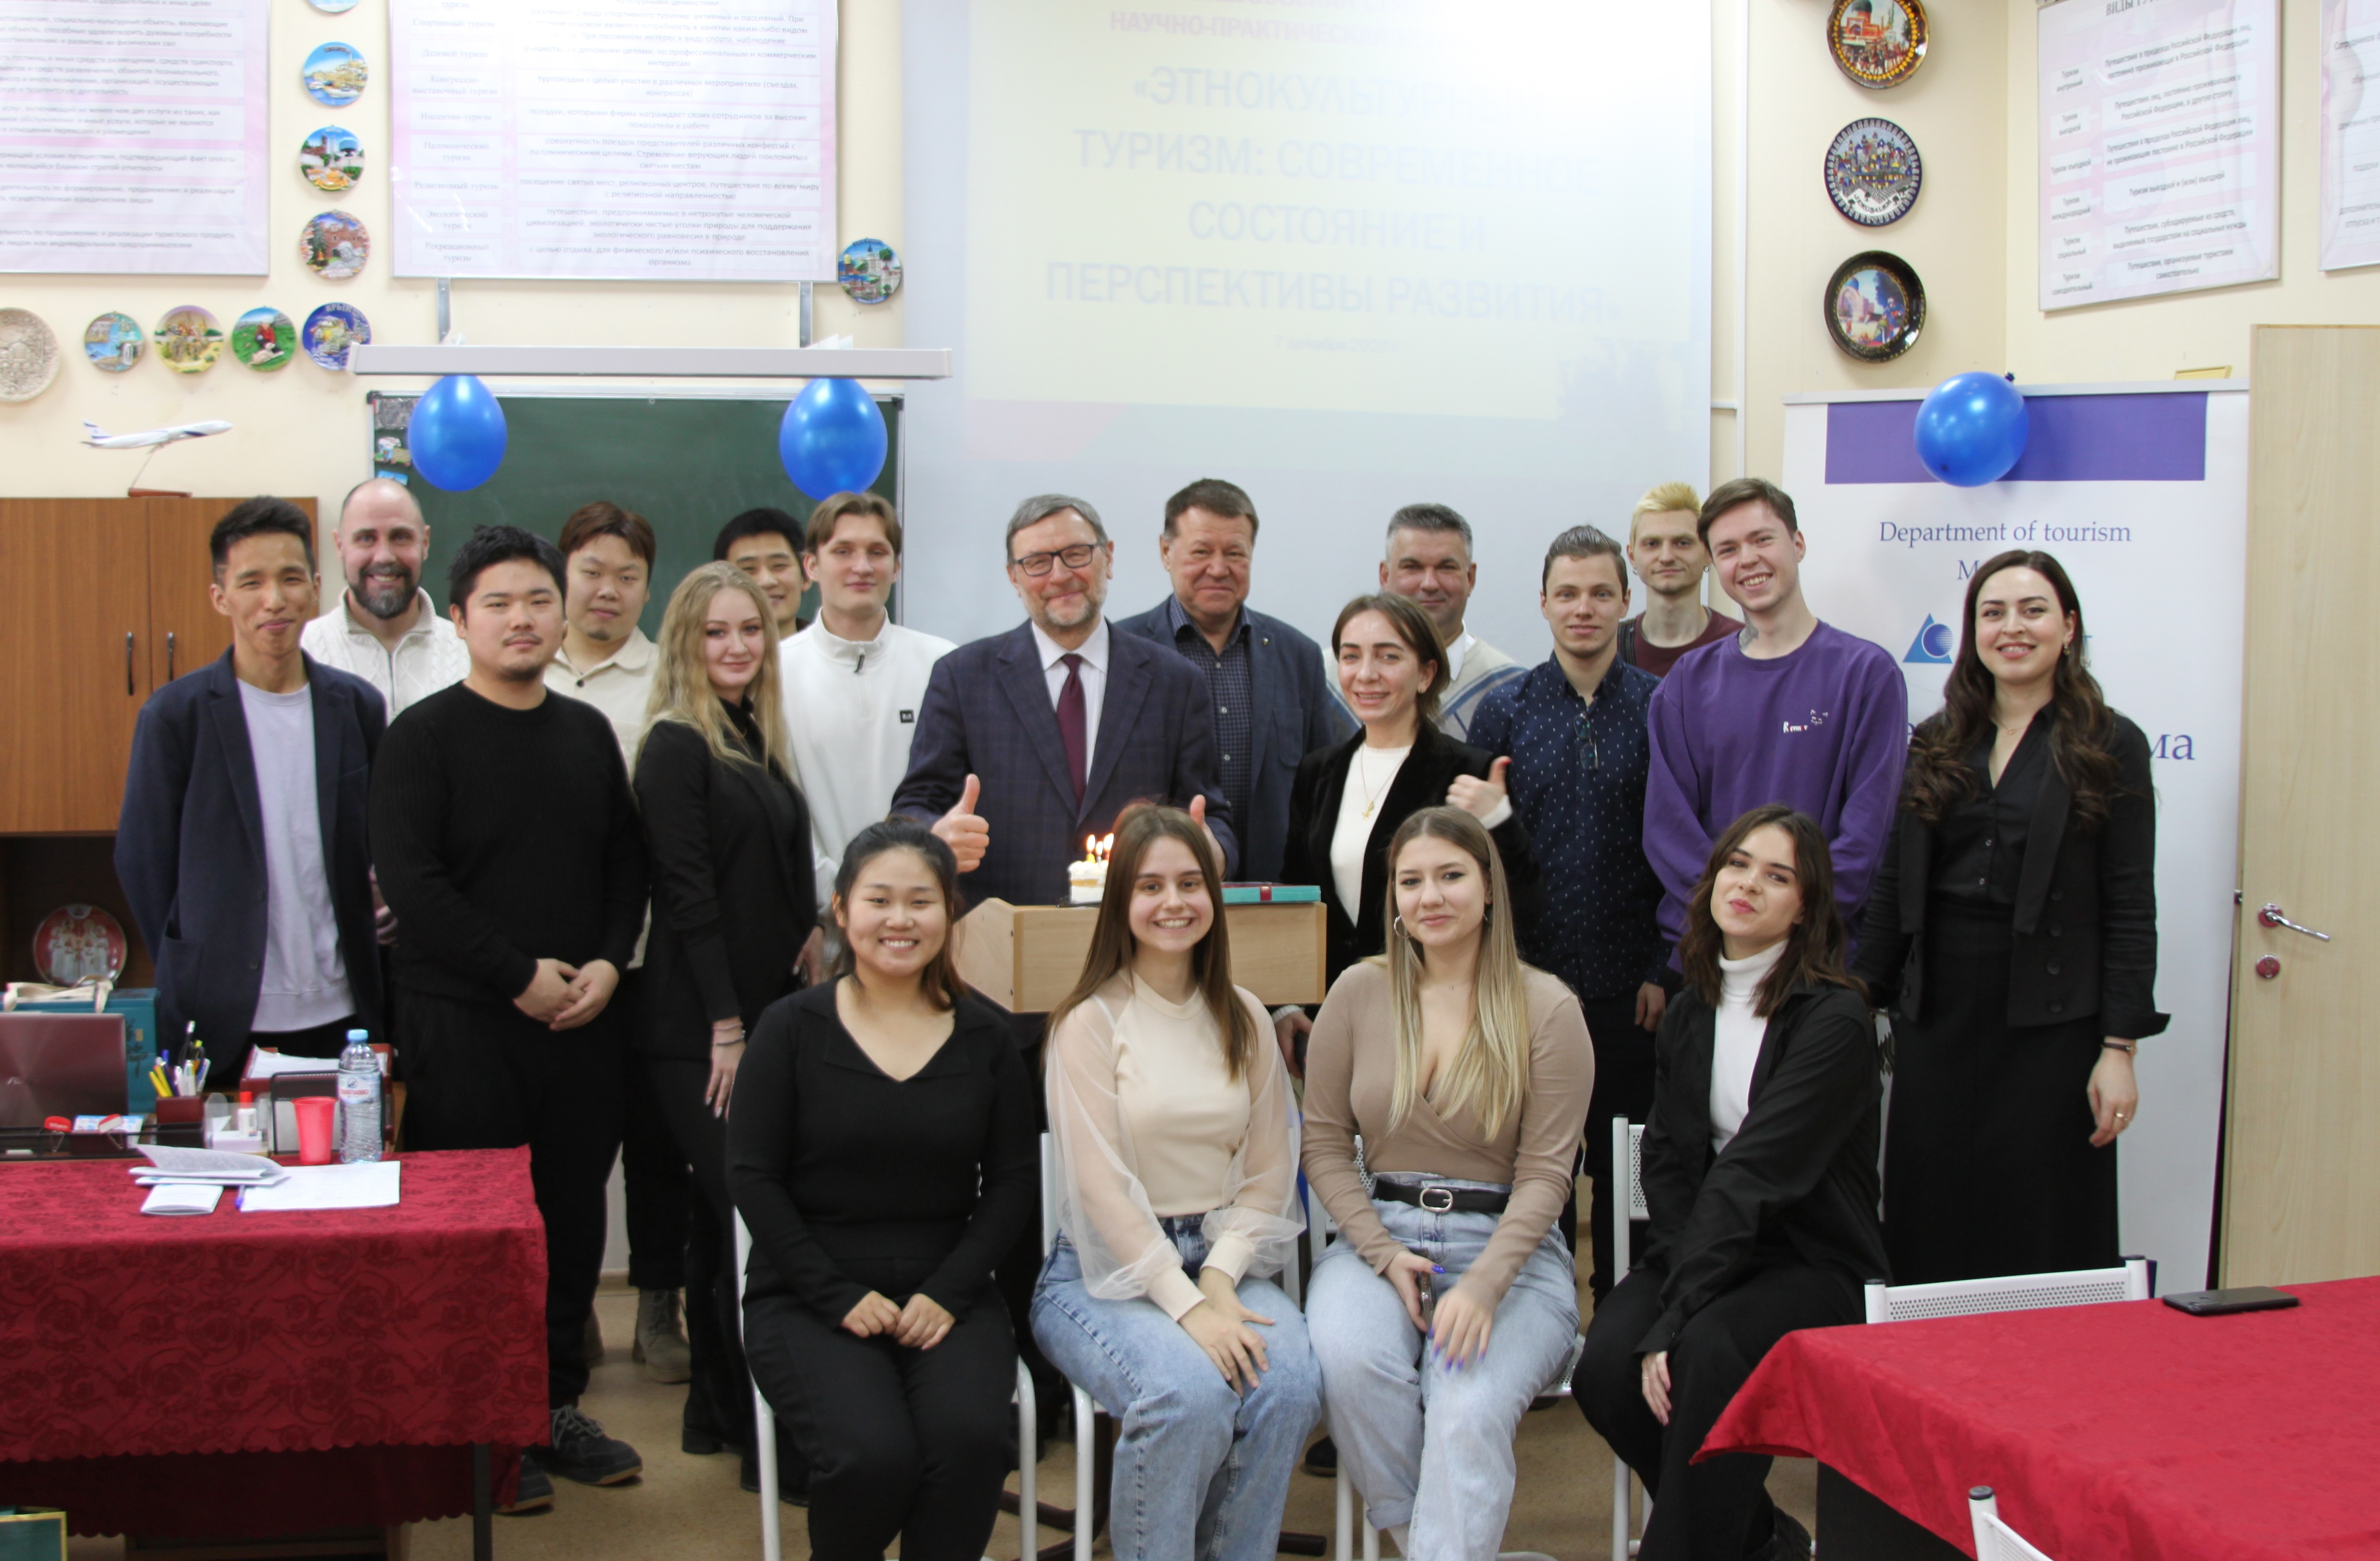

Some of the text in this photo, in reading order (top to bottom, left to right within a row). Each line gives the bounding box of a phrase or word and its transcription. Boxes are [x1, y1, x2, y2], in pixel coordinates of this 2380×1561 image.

[581, 32, 598, 41] При
[706, 36, 735, 44] спорта,
[422, 49, 458, 57] Деловой
[578, 47, 622, 55] деловыми
[669, 49, 749, 57] профессиональным
[537, 76, 585, 84] турпоездки
[704, 80, 762, 88] мероприятиях
[763, 81, 800, 89] (съездах,
[529, 108, 567, 116] поездки,
[639, 111, 686, 119] награждает
[711, 112, 763, 120] сотрудников
[601, 138, 636, 146] поездок
[637, 140, 702, 148] представителей
[636, 150, 685, 158] Стремление
[1073, 127, 1603, 196] ТУРИЗМ: СОВРЕМЕННОЕ
[546, 208, 601, 216] путешествия,
[1188, 199, 1487, 253] СОСТОЯНИЕ И
[1044, 259, 1623, 326] ПЕРСПЕКТИВЫ РАЗВИТИЯ»
[1879, 519, 2132, 548] Department of tourism
